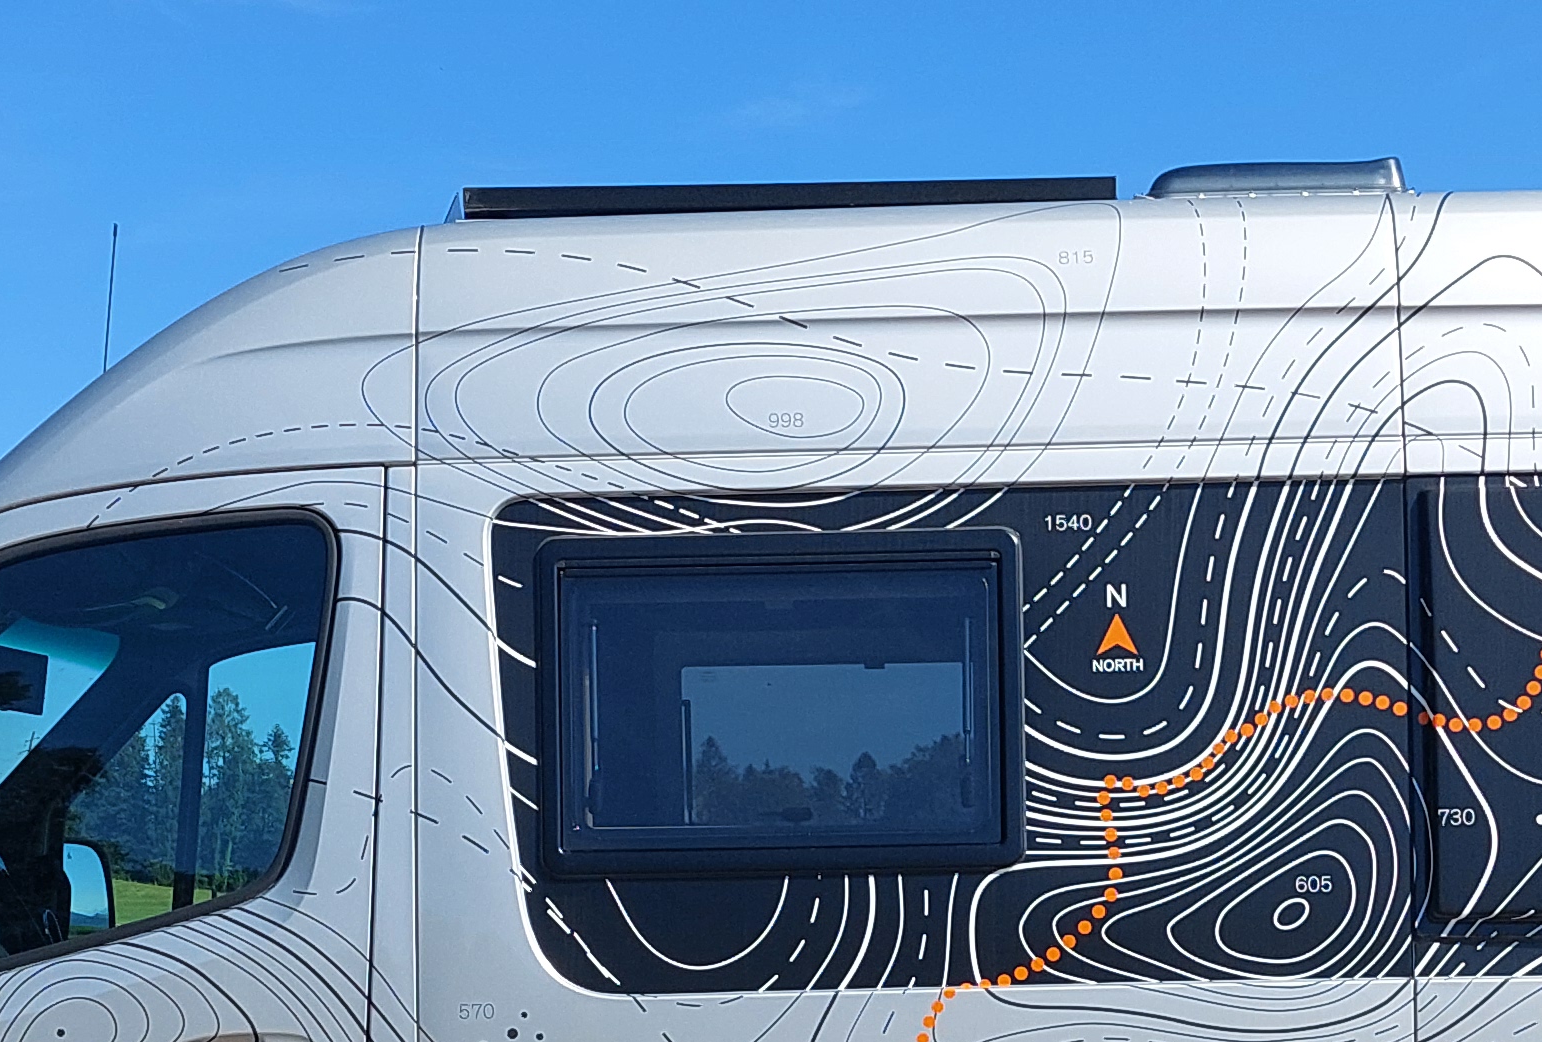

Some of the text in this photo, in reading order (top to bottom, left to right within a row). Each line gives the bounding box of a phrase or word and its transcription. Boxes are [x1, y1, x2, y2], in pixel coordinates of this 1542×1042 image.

[1058, 250, 1094, 265] 815
[768, 412, 804, 428] 998
[1044, 514, 1093, 532] 1540
[1106, 583, 1127, 608] N
[1092, 658, 1144, 673] NORTH
[1437, 808, 1476, 827] 730
[1295, 875, 1333, 893] 605
[459, 1003, 495, 1020] 570
